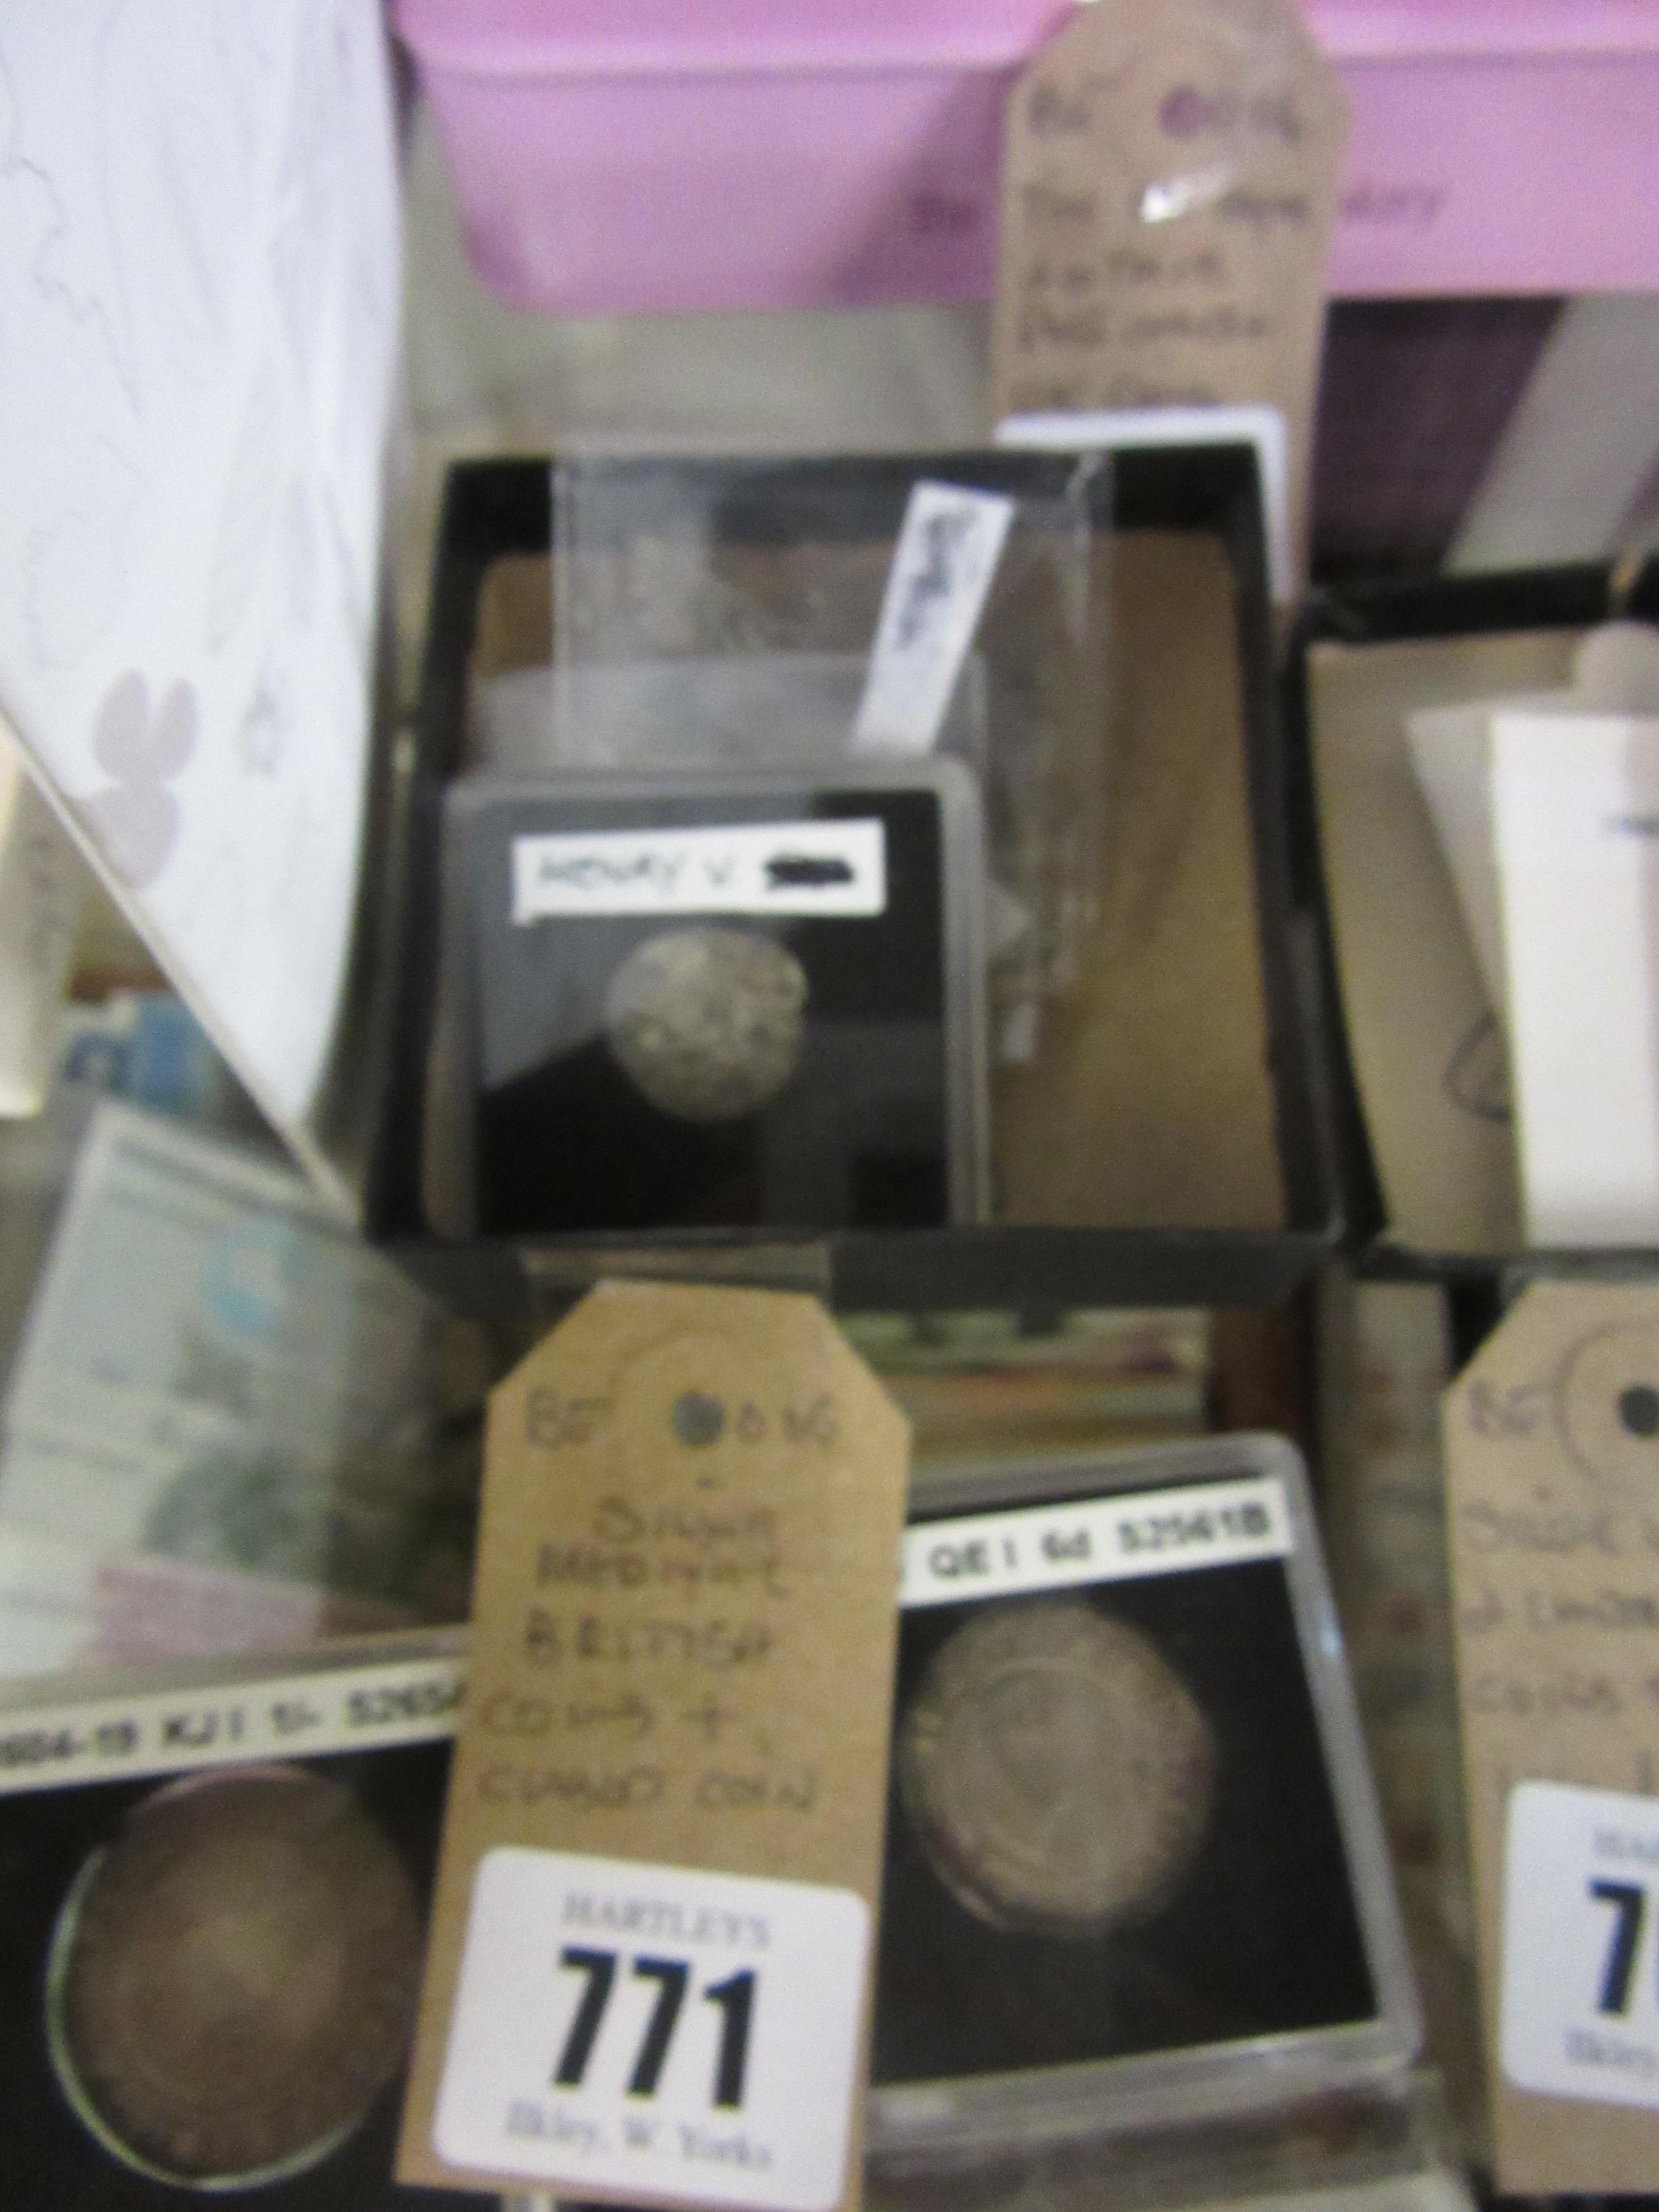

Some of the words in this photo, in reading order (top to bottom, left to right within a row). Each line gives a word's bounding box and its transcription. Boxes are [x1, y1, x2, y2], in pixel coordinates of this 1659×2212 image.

[562, 1891, 773, 1950] HARTLEYS
[1587, 1872, 1659, 2022] 7
[553, 1944, 758, 2113] 771
